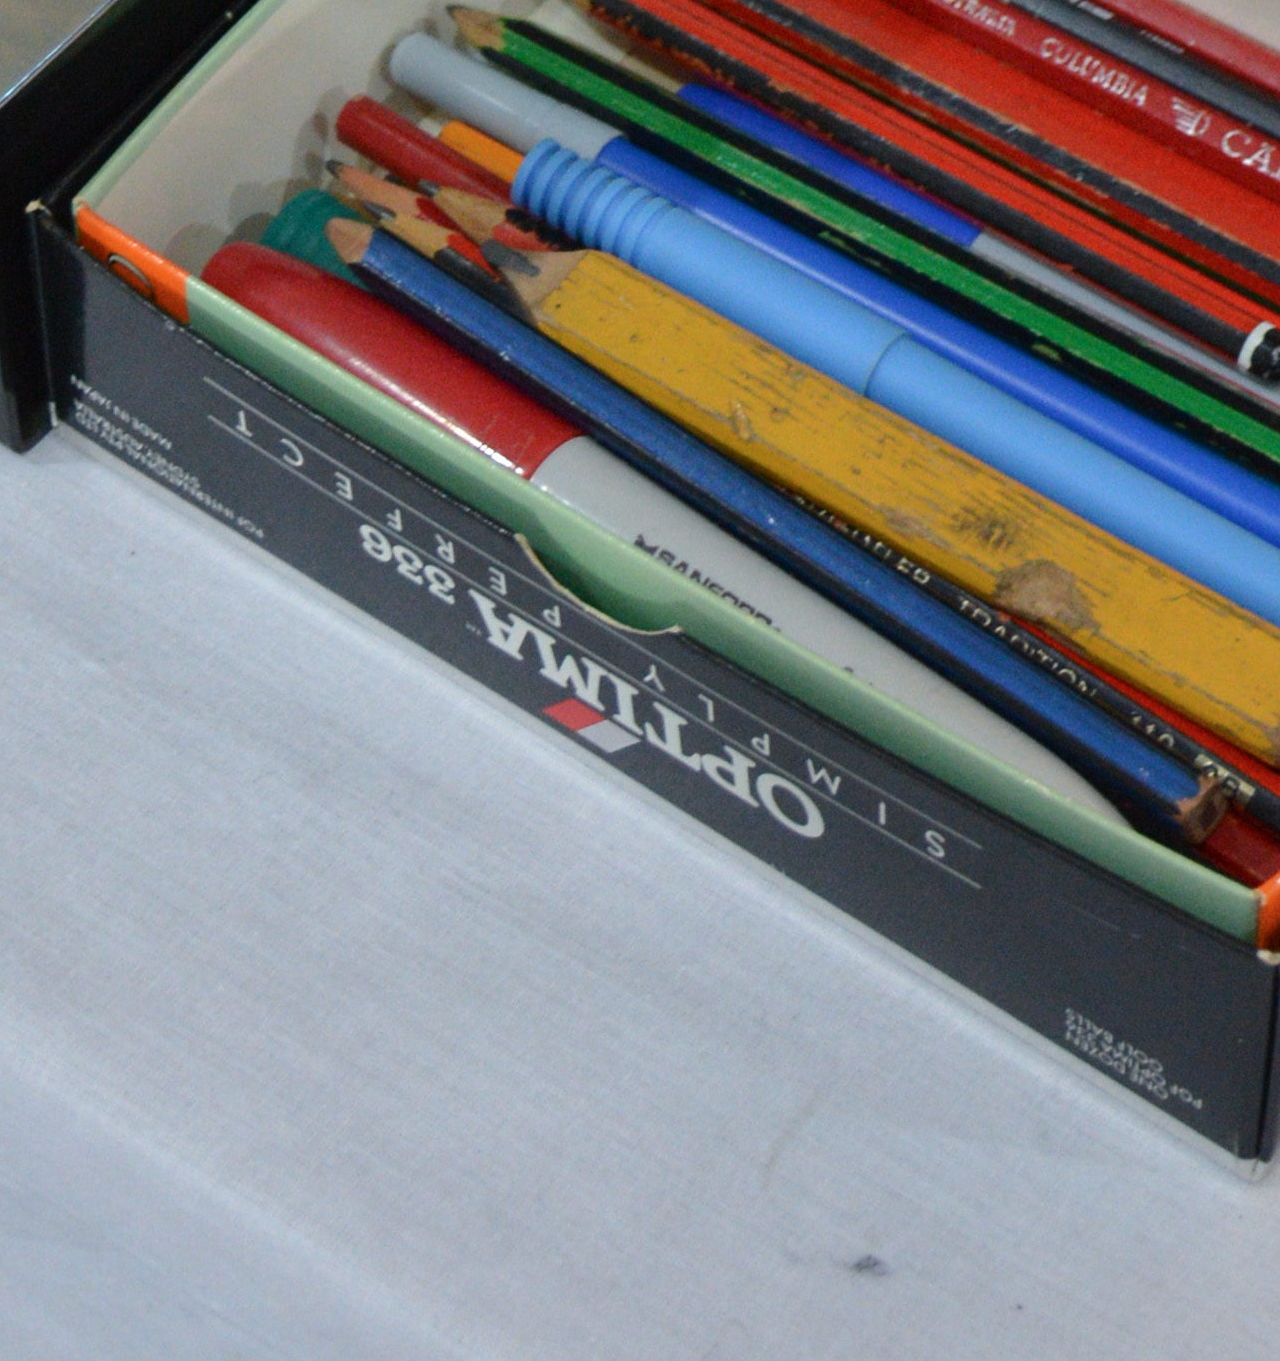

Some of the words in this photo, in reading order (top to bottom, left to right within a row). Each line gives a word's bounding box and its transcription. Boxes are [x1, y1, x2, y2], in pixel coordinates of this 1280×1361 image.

[1040, 34, 1151, 109] COLUMBIA
[70, 374, 111, 410] JAPAN
[113, 405, 130, 423] IN
[131, 417, 172, 450] MADE
[233, 409, 561, 627] PERFECT
[359, 522, 457, 605] 336
[468, 589, 824, 839] OPTIMA
[642, 663, 946, 859] SIMPLY
[1064, 1007, 1113, 1043] BALLS
[1065, 1031, 1127, 1073] DOZEN
[1098, 1042, 1167, 1086] OPTIMA
[1115, 1041, 1165, 1073] GOLF
[1127, 1069, 1170, 1100] ONE
